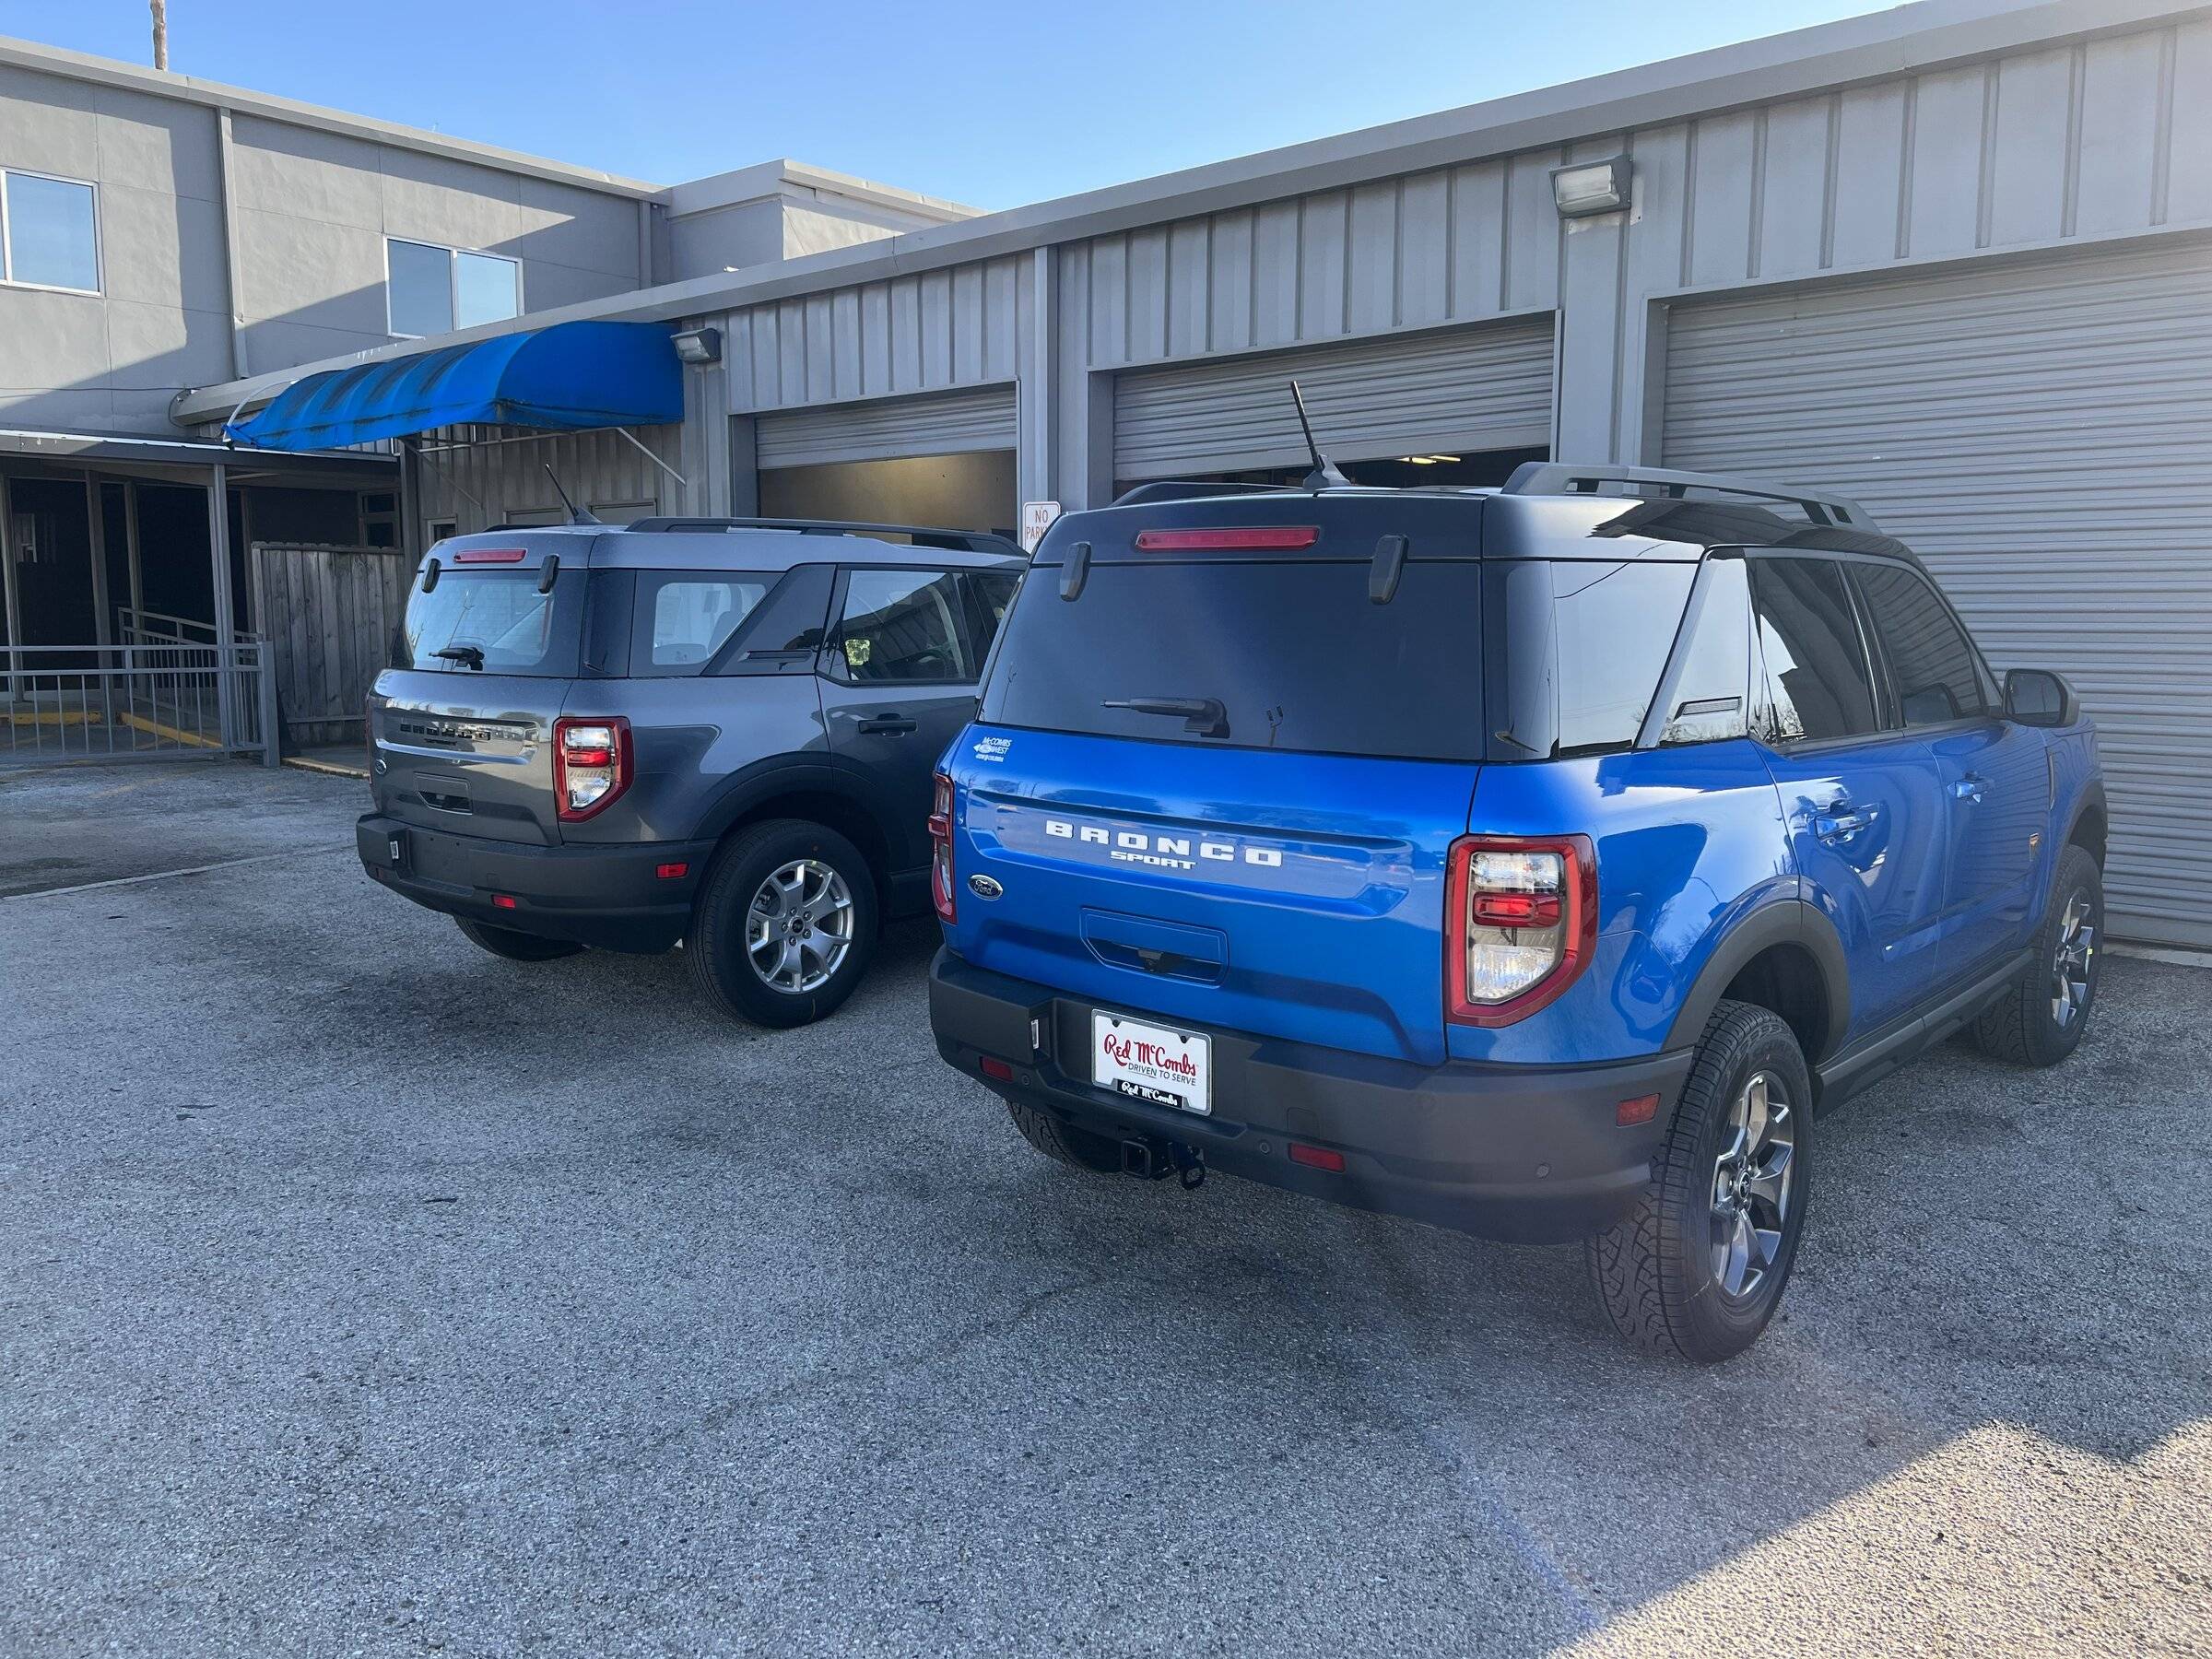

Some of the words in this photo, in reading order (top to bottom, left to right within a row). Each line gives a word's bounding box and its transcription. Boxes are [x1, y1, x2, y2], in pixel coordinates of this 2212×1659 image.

[1035, 510, 1048, 523] NO
[1046, 820, 1283, 867] BRONCO
[1110, 851, 1196, 870] SPORT
[973, 879, 994, 895] Ford
[1104, 1034, 1131, 1066] Red
[1134, 1041, 1196, 1077] McCombs
[1128, 1063, 1157, 1077] DRIVEN
[1159, 1069, 1170, 1079] TO
[1171, 1074, 1196, 1086] SERVE
[1121, 1081, 1139, 1096] Red
